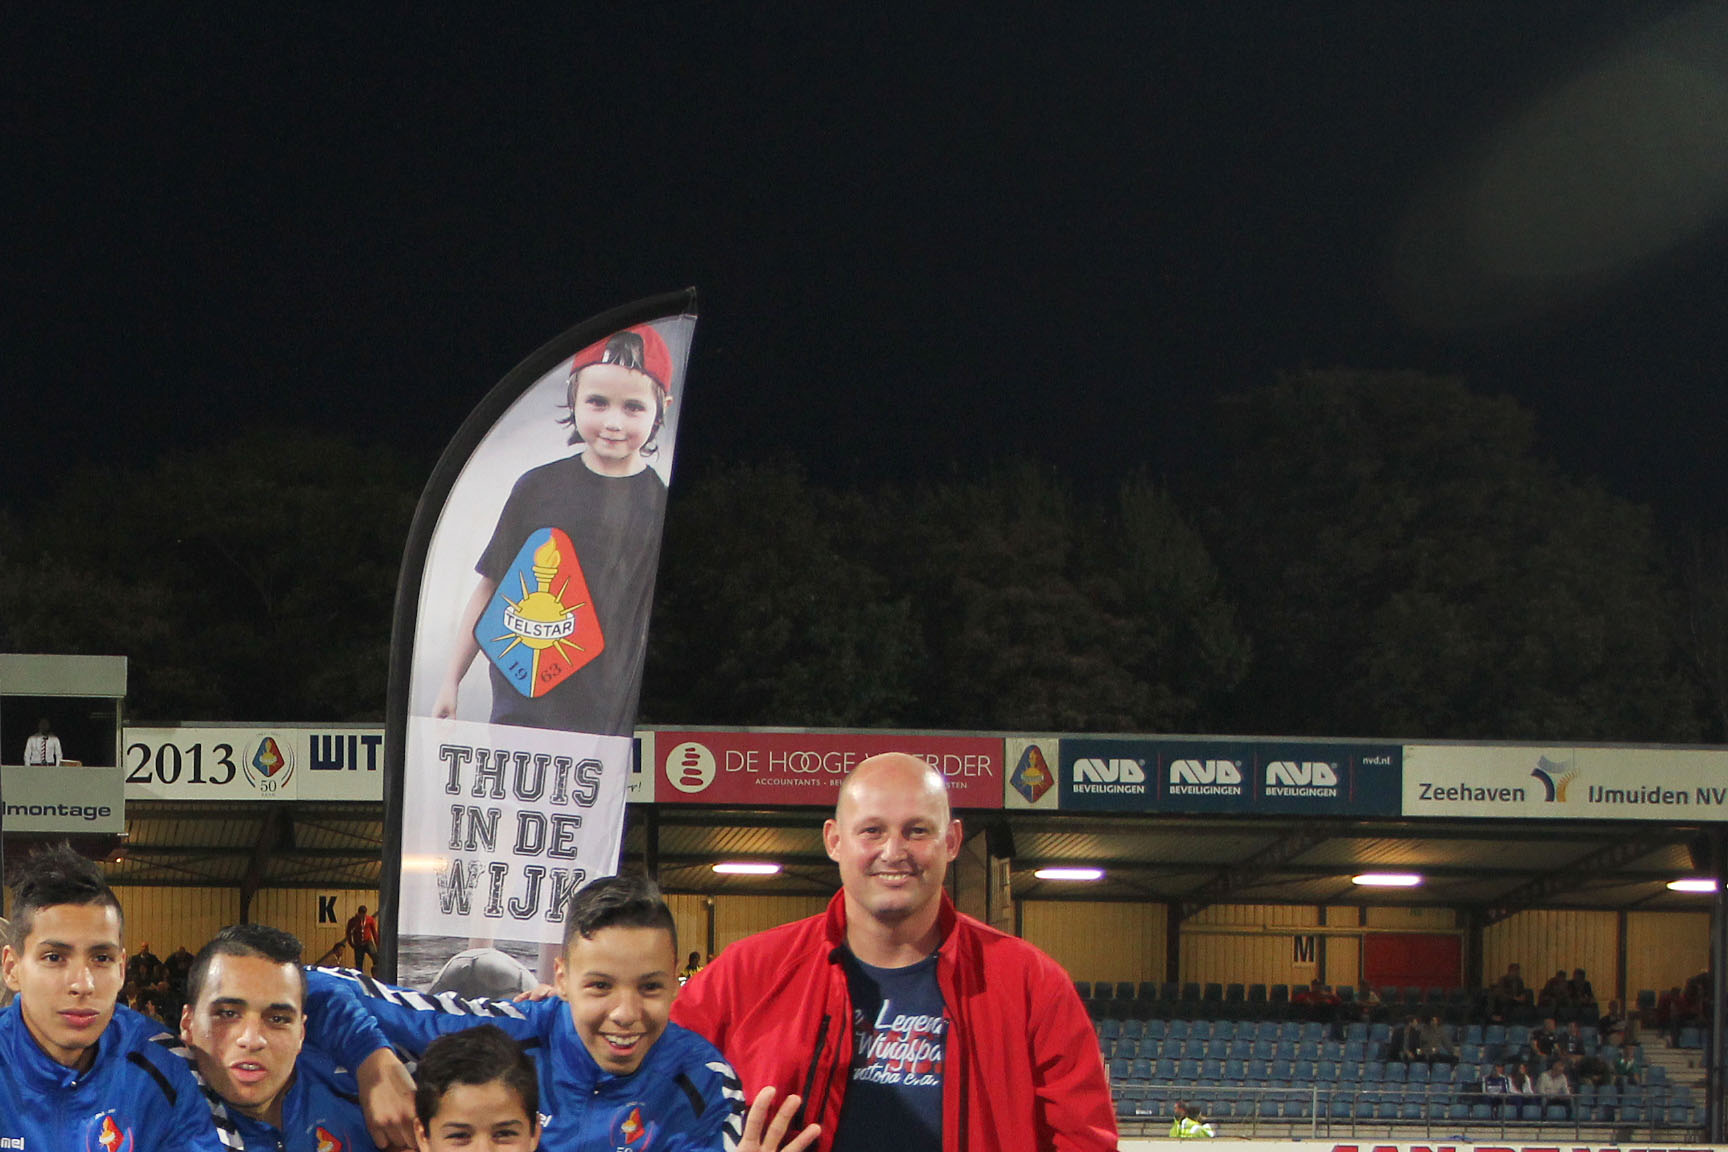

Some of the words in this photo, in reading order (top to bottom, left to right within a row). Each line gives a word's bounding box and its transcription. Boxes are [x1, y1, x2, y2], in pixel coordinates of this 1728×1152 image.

[505, 613, 573, 638] TELSTAR
[509, 660, 529, 682] 19
[125, 742, 237, 785] 2013
[309, 734, 383, 771] WIT
[724, 750, 760, 773] DE
[768, 750, 856, 774] HOOGE
[1362, 756, 1391, 766] nvd.nl
[259, 780, 277, 793] 50
[439, 743, 604, 808] THUIS
[755, 777, 822, 787] ACCOUNTANTS
[1073, 784, 1145, 795] BEVEILIGINGEN
[1169, 785, 1241, 796] BEVEILIGINGEN
[1266, 786, 1337, 798] BEVEILIGINGEN
[1419, 783, 1525, 802] Zeehaven
[1588, 785, 1689, 805] IJmuiden
[1696, 787, 1726, 805] NV
[449, 803, 502, 852] IN
[513, 809, 583, 860] DE
[434, 857, 587, 924] WIJK
[319, 895, 338, 924] K
[1293, 935, 1315, 963] M
